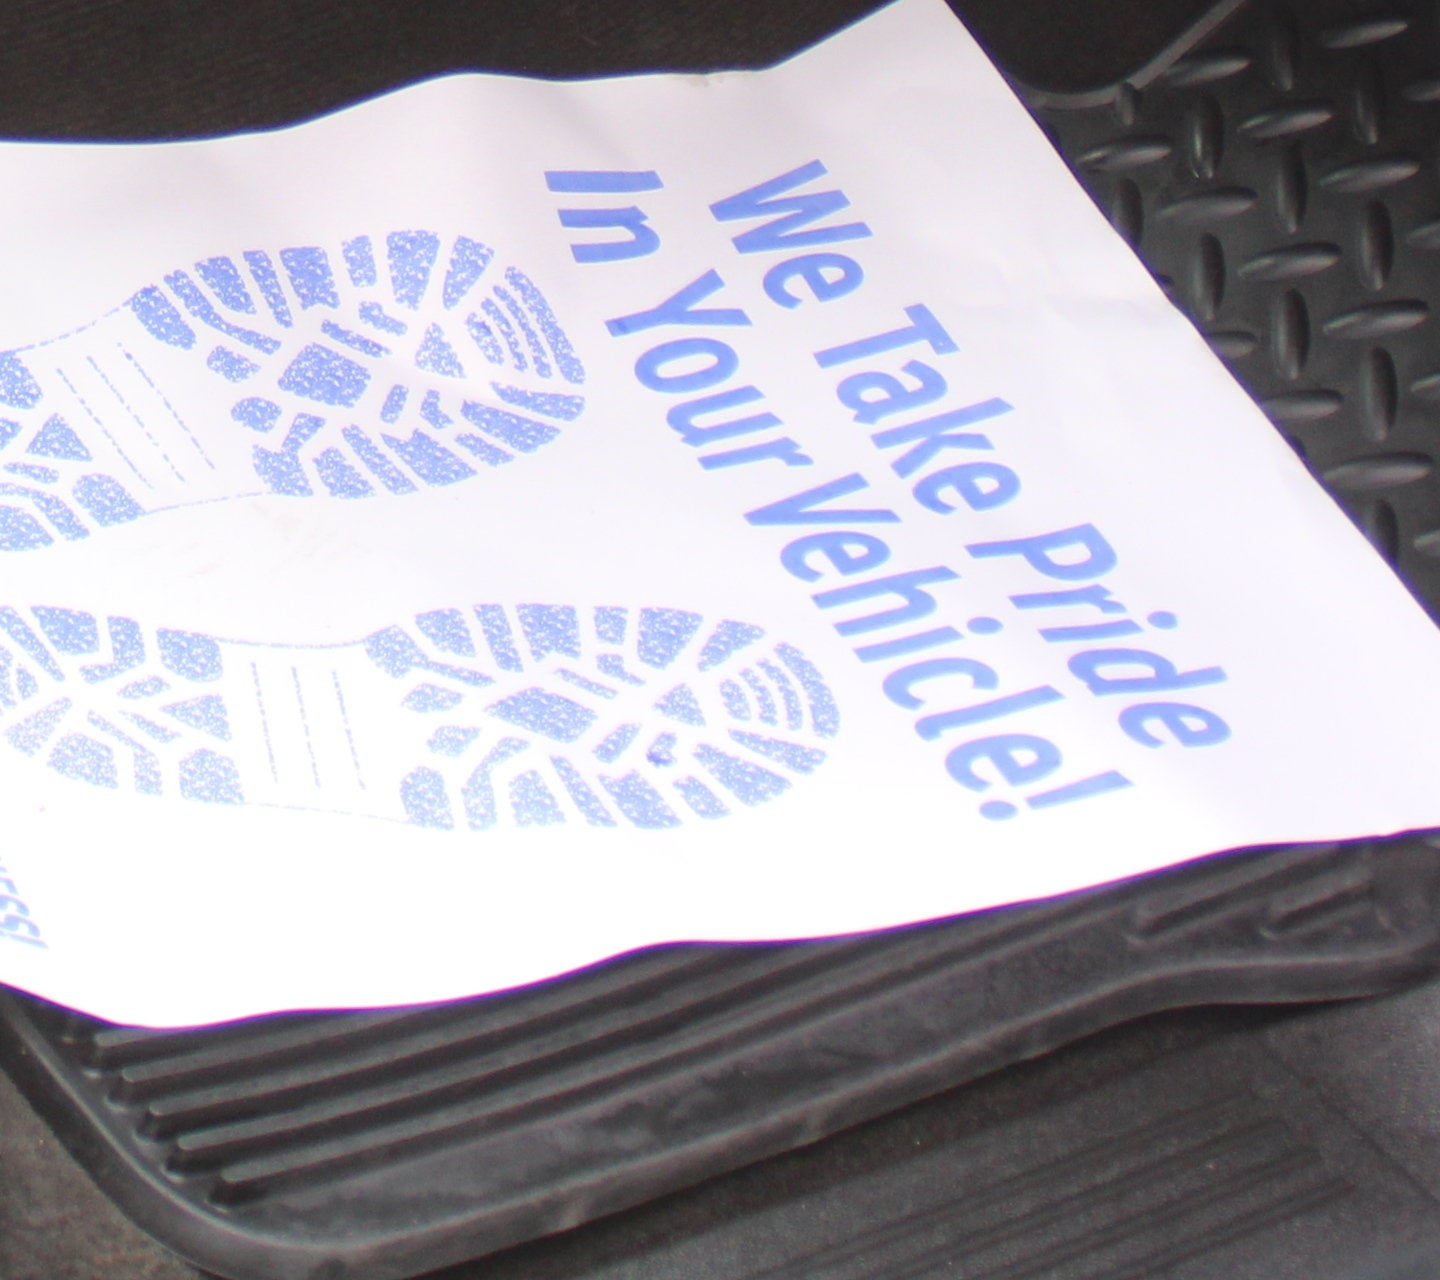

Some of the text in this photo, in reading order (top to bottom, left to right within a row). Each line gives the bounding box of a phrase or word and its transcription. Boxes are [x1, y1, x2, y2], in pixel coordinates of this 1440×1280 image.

[544, 170, 1135, 821] In Your Vehicle!
[708, 158, 1233, 749] We Take Pride
